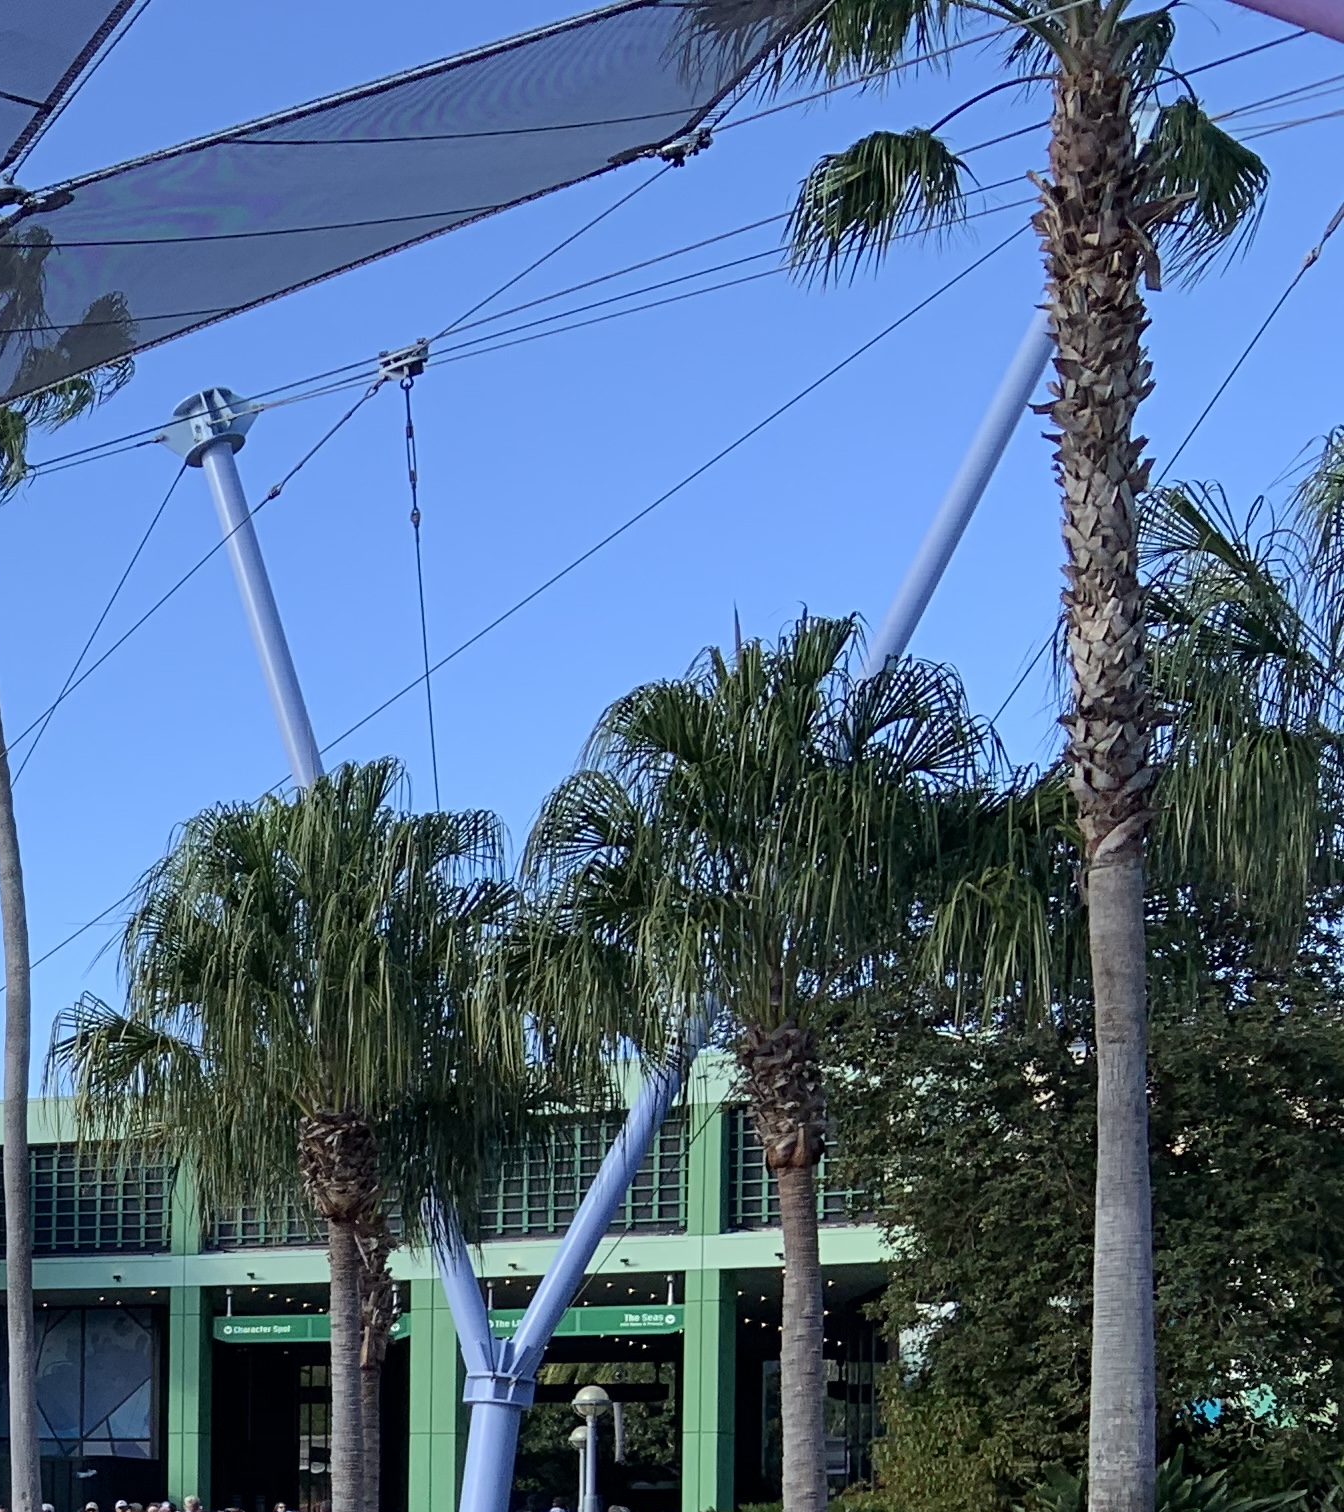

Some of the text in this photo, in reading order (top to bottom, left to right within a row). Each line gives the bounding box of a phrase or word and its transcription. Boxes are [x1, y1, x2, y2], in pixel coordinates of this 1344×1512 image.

[624, 1313, 664, 1322] The Seas
[495, 1319, 510, 1328] The
[233, 1325, 291, 1335] Character Spot
